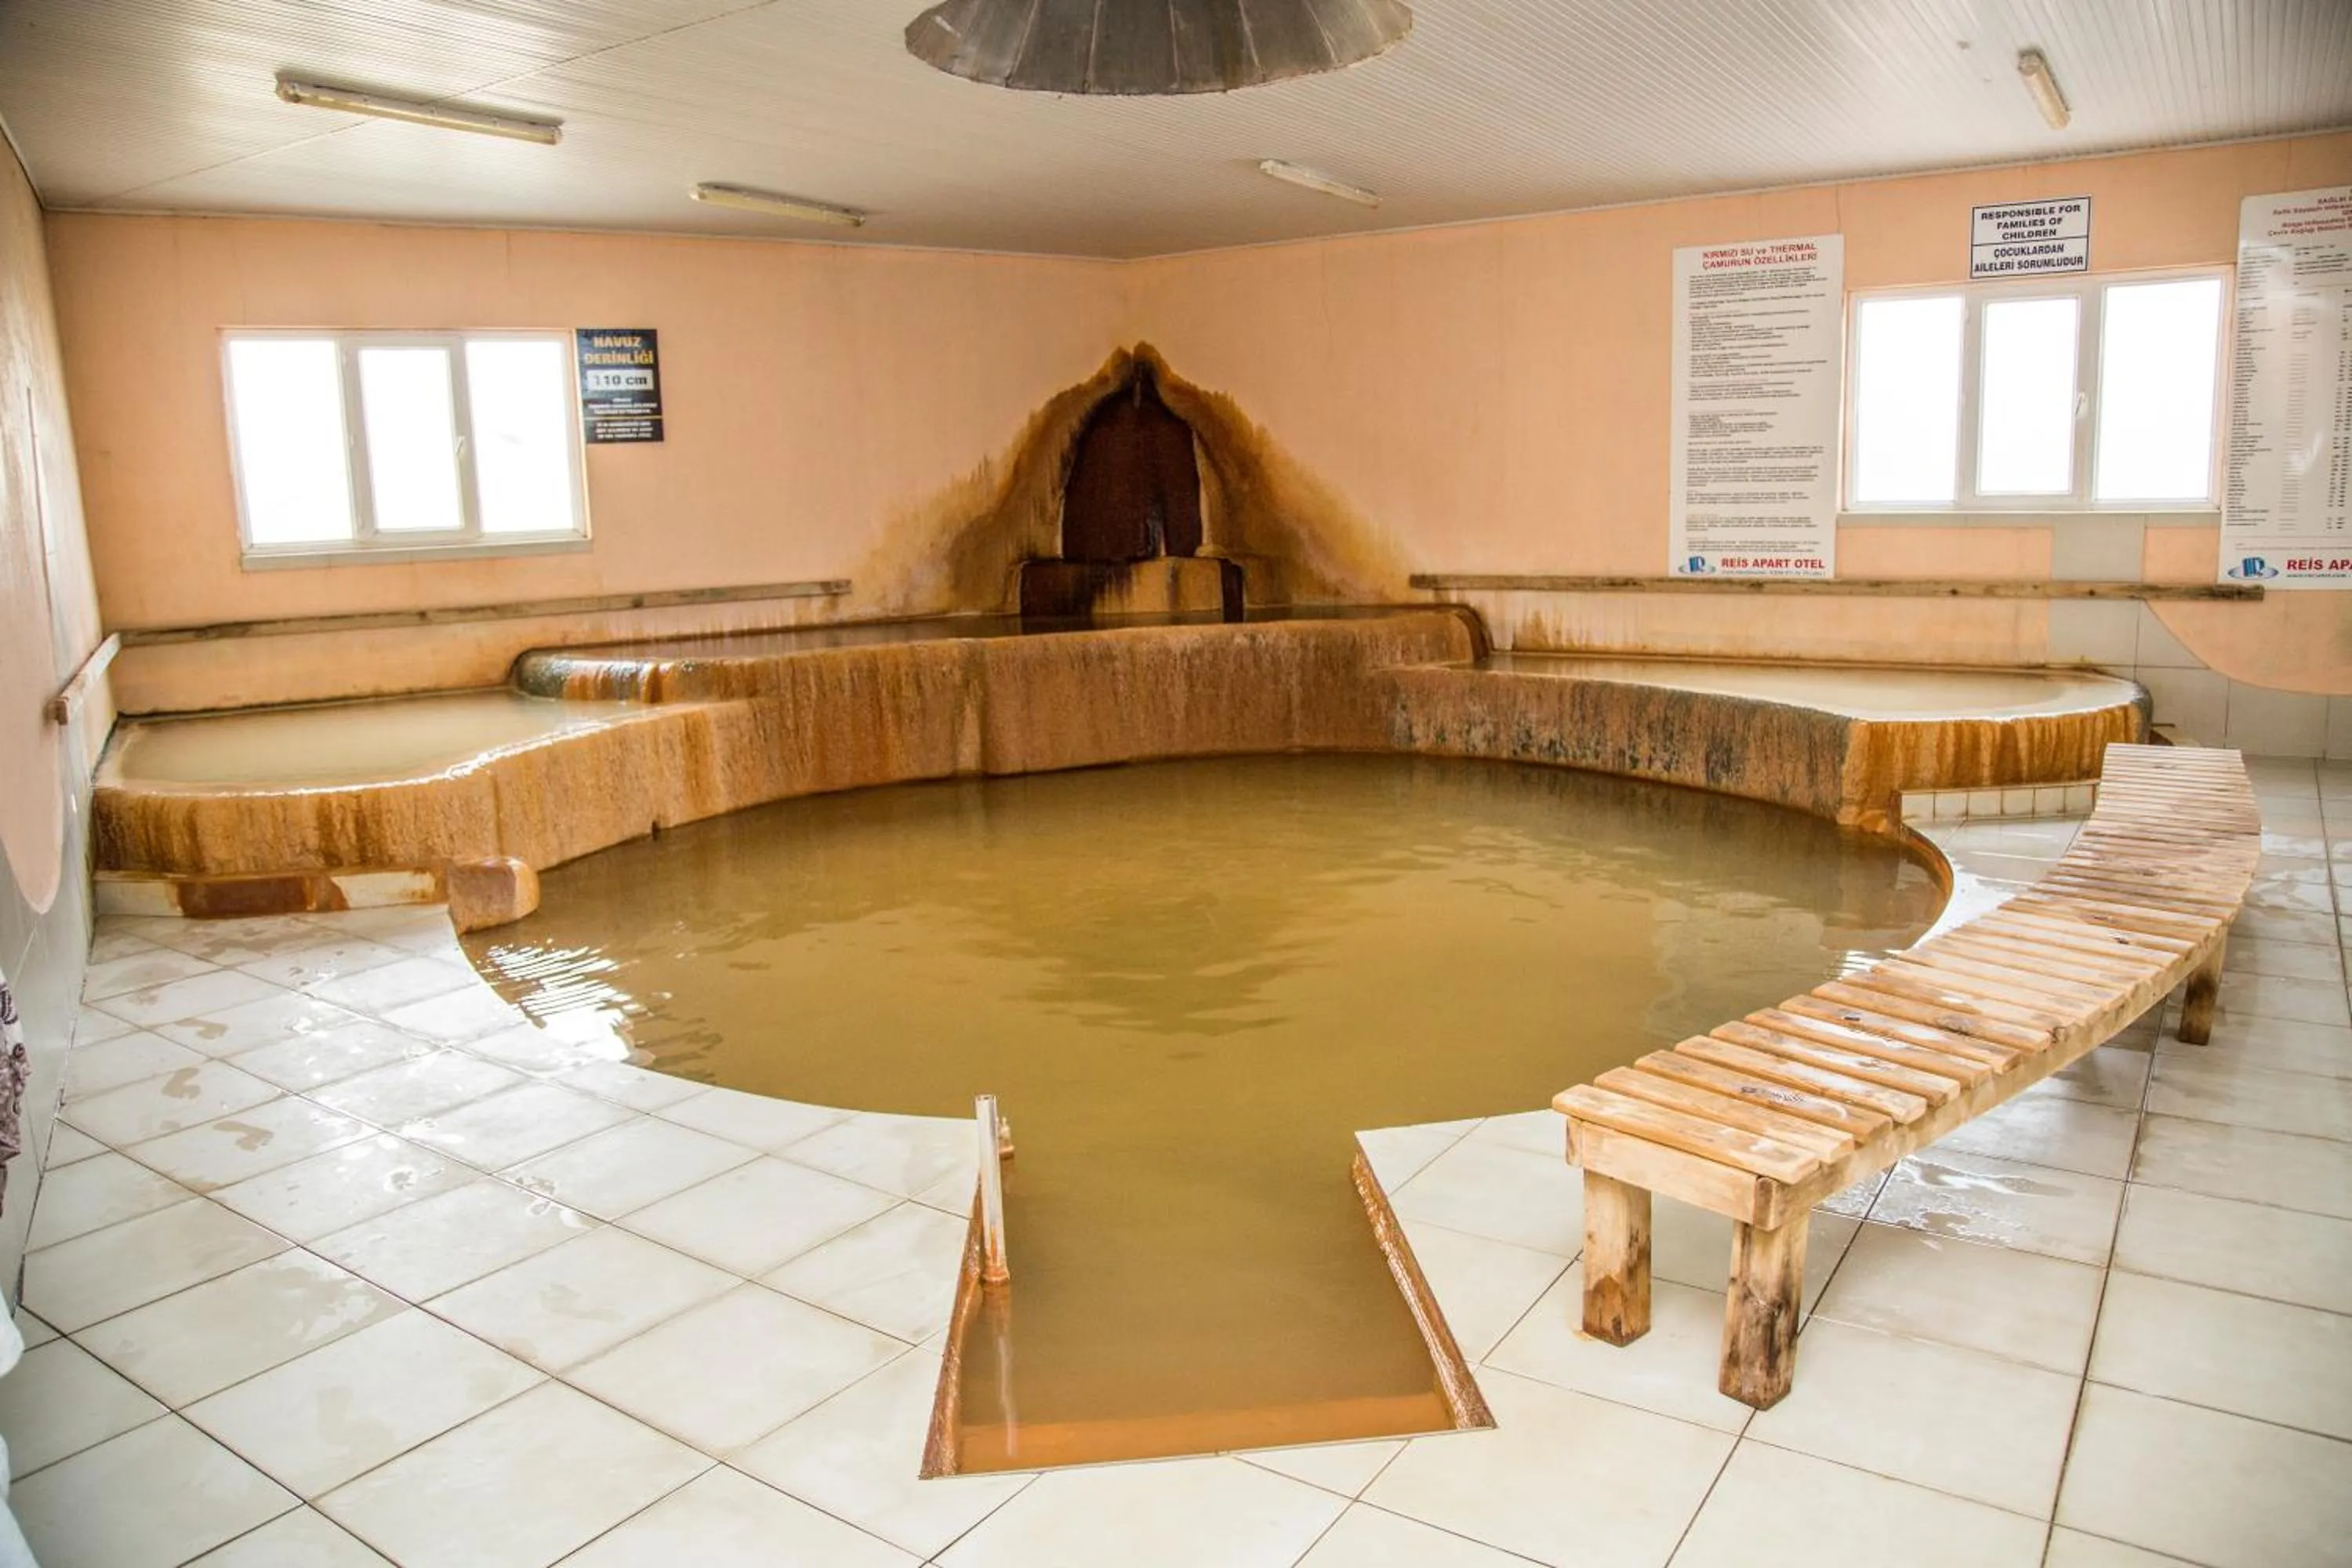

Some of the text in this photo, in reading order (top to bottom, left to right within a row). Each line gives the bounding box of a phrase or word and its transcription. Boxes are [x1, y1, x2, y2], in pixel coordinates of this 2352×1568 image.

[1981, 204, 2082, 220] RESPONSIBLE FOR
[1997, 217, 2063, 230] FAMILIES OF
[2002, 228, 2056, 240] CHILDREN
[1703, 249, 1738, 260] KIRMIZI
[1740, 247, 1754, 256] SU
[1769, 242, 1817, 254] THERMAL
[1994, 244, 2064, 260] ÇOCUKLARDAN
[1702, 258, 1751, 270] ÇAMURUN
[2017, 256, 2083, 270] SORUMLUDUR
[593, 336, 641, 348] HAVUZ
[584, 350, 654, 365] DERİNLİĞİ
[593, 375, 648, 387] 110 cm
[1722, 556, 1825, 568] REİS APART OTEL
[2286, 557, 2323, 570] REİS
